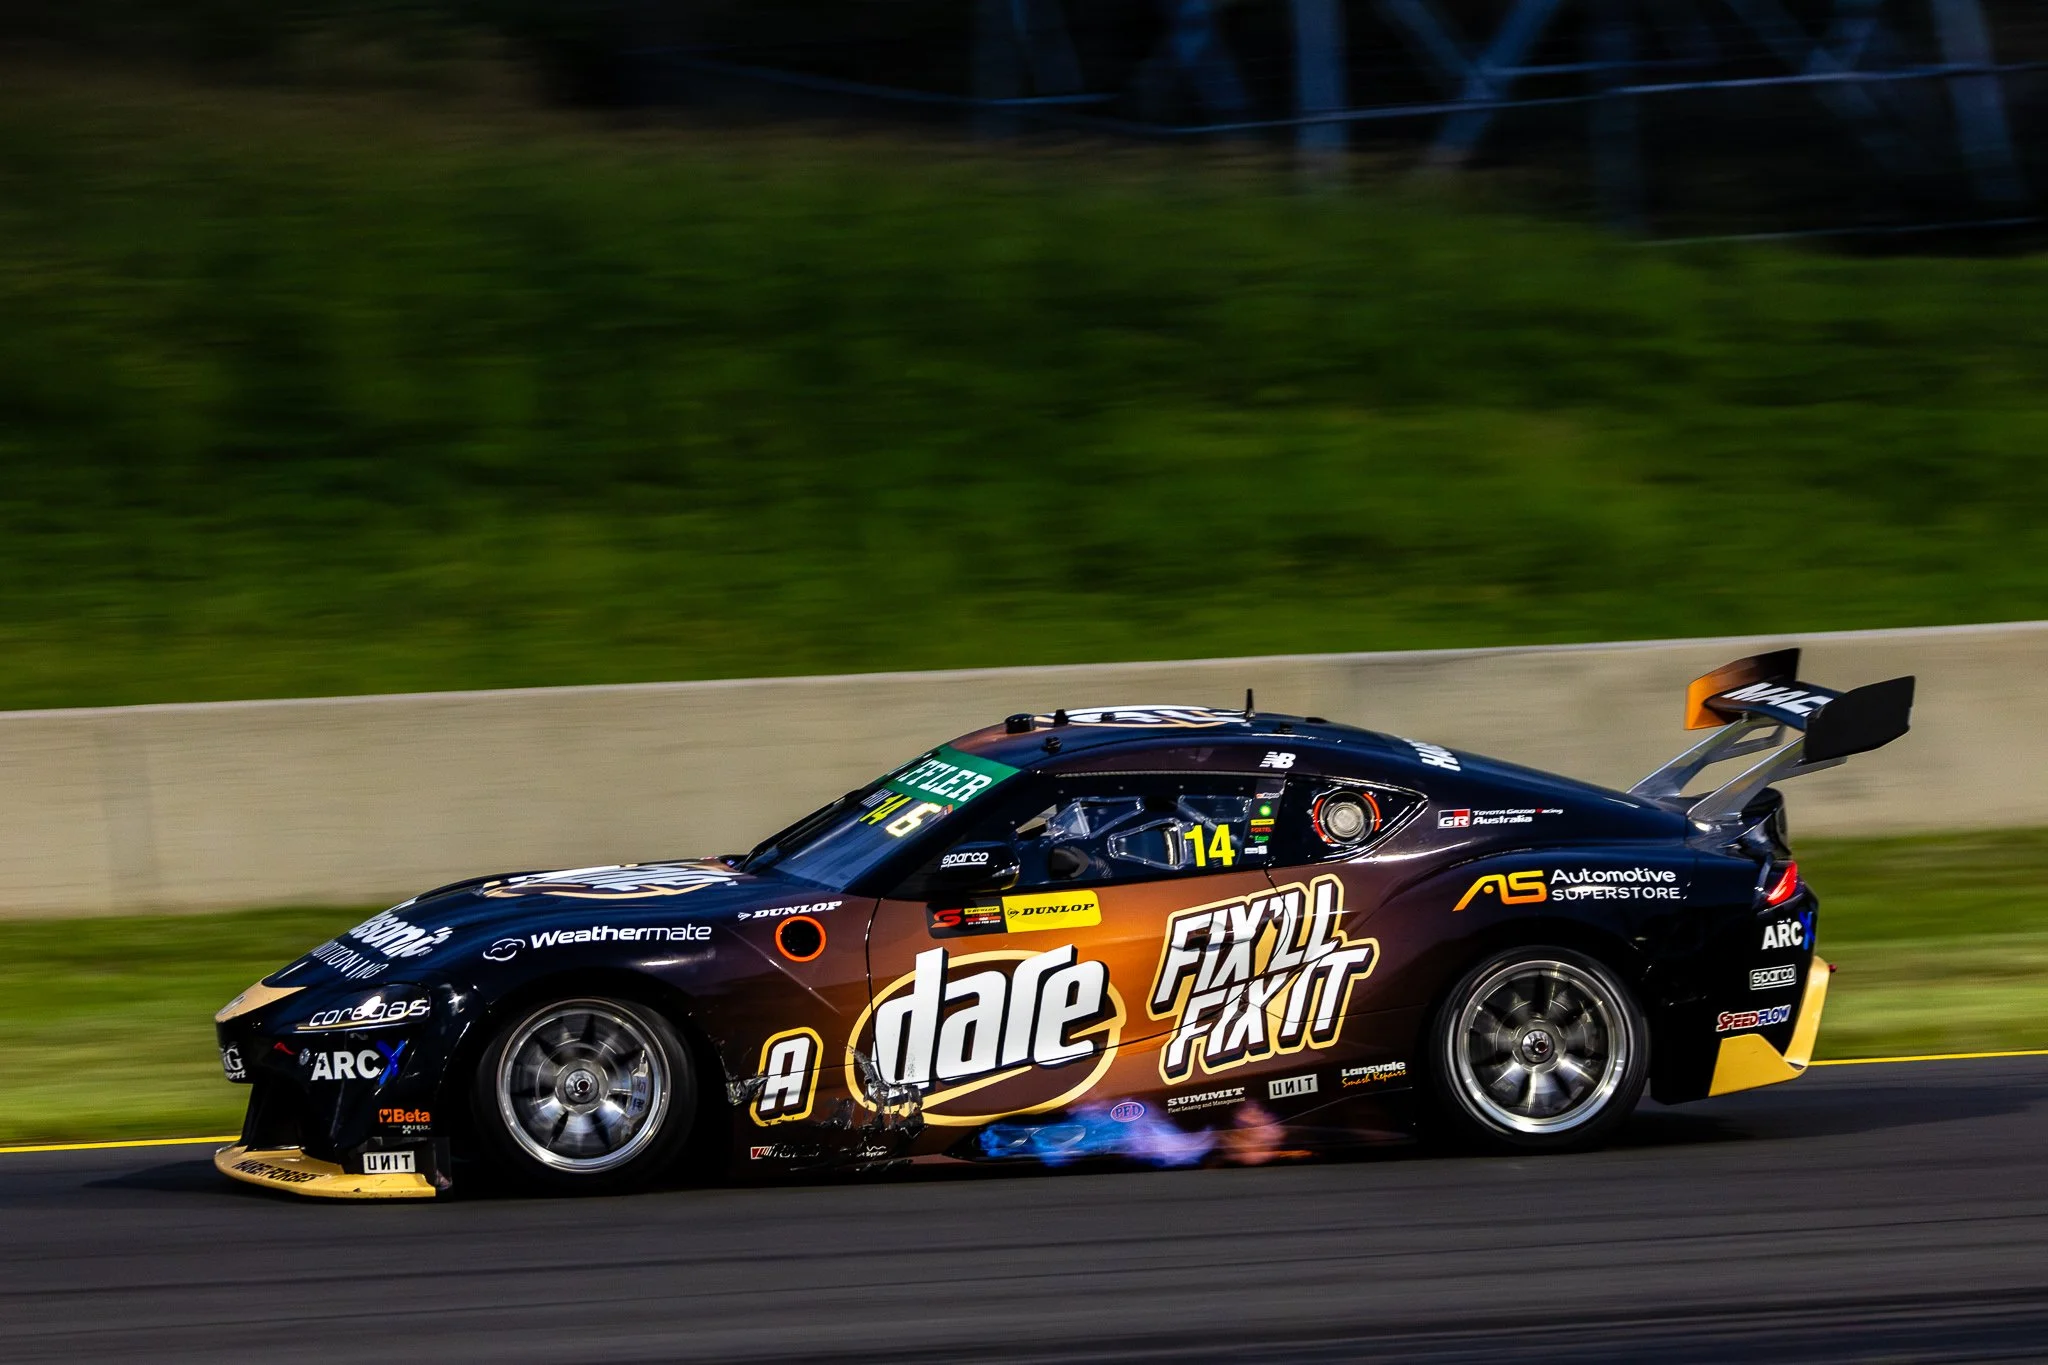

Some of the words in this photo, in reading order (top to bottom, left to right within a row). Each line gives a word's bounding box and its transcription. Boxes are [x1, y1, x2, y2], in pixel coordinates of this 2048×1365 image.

[859, 794, 912, 825] 14
[886, 802, 942, 837] 6
[1439, 816, 1469, 827] GR
[1473, 815, 1533, 825] Australia
[1184, 824, 1236, 867] 14
[942, 852, 989, 869] sparco
[1551, 868, 1676, 885] Automotive
[1552, 886, 1681, 901] SUPERSTORE
[753, 901, 842, 918] DUNLOP
[1021, 903, 1095, 916] DUNLOP
[530, 923, 712, 949] Weathermate
[1153, 883, 1339, 1004] FIX'LL
[1752, 966, 1796, 986] sparco
[309, 999, 430, 1027] coregas
[874, 944, 1106, 1092] dare
[1167, 972, 1291, 1068] FIX
[759, 1036, 810, 1112] A
[1341, 1061, 1406, 1077] Lansvale
[1341, 1073, 1371, 1088] Smash
[1373, 1070, 1406, 1082] Repairs
[1167, 1087, 1245, 1106] SUMMIT
[394, 1109, 430, 1122] Beta
